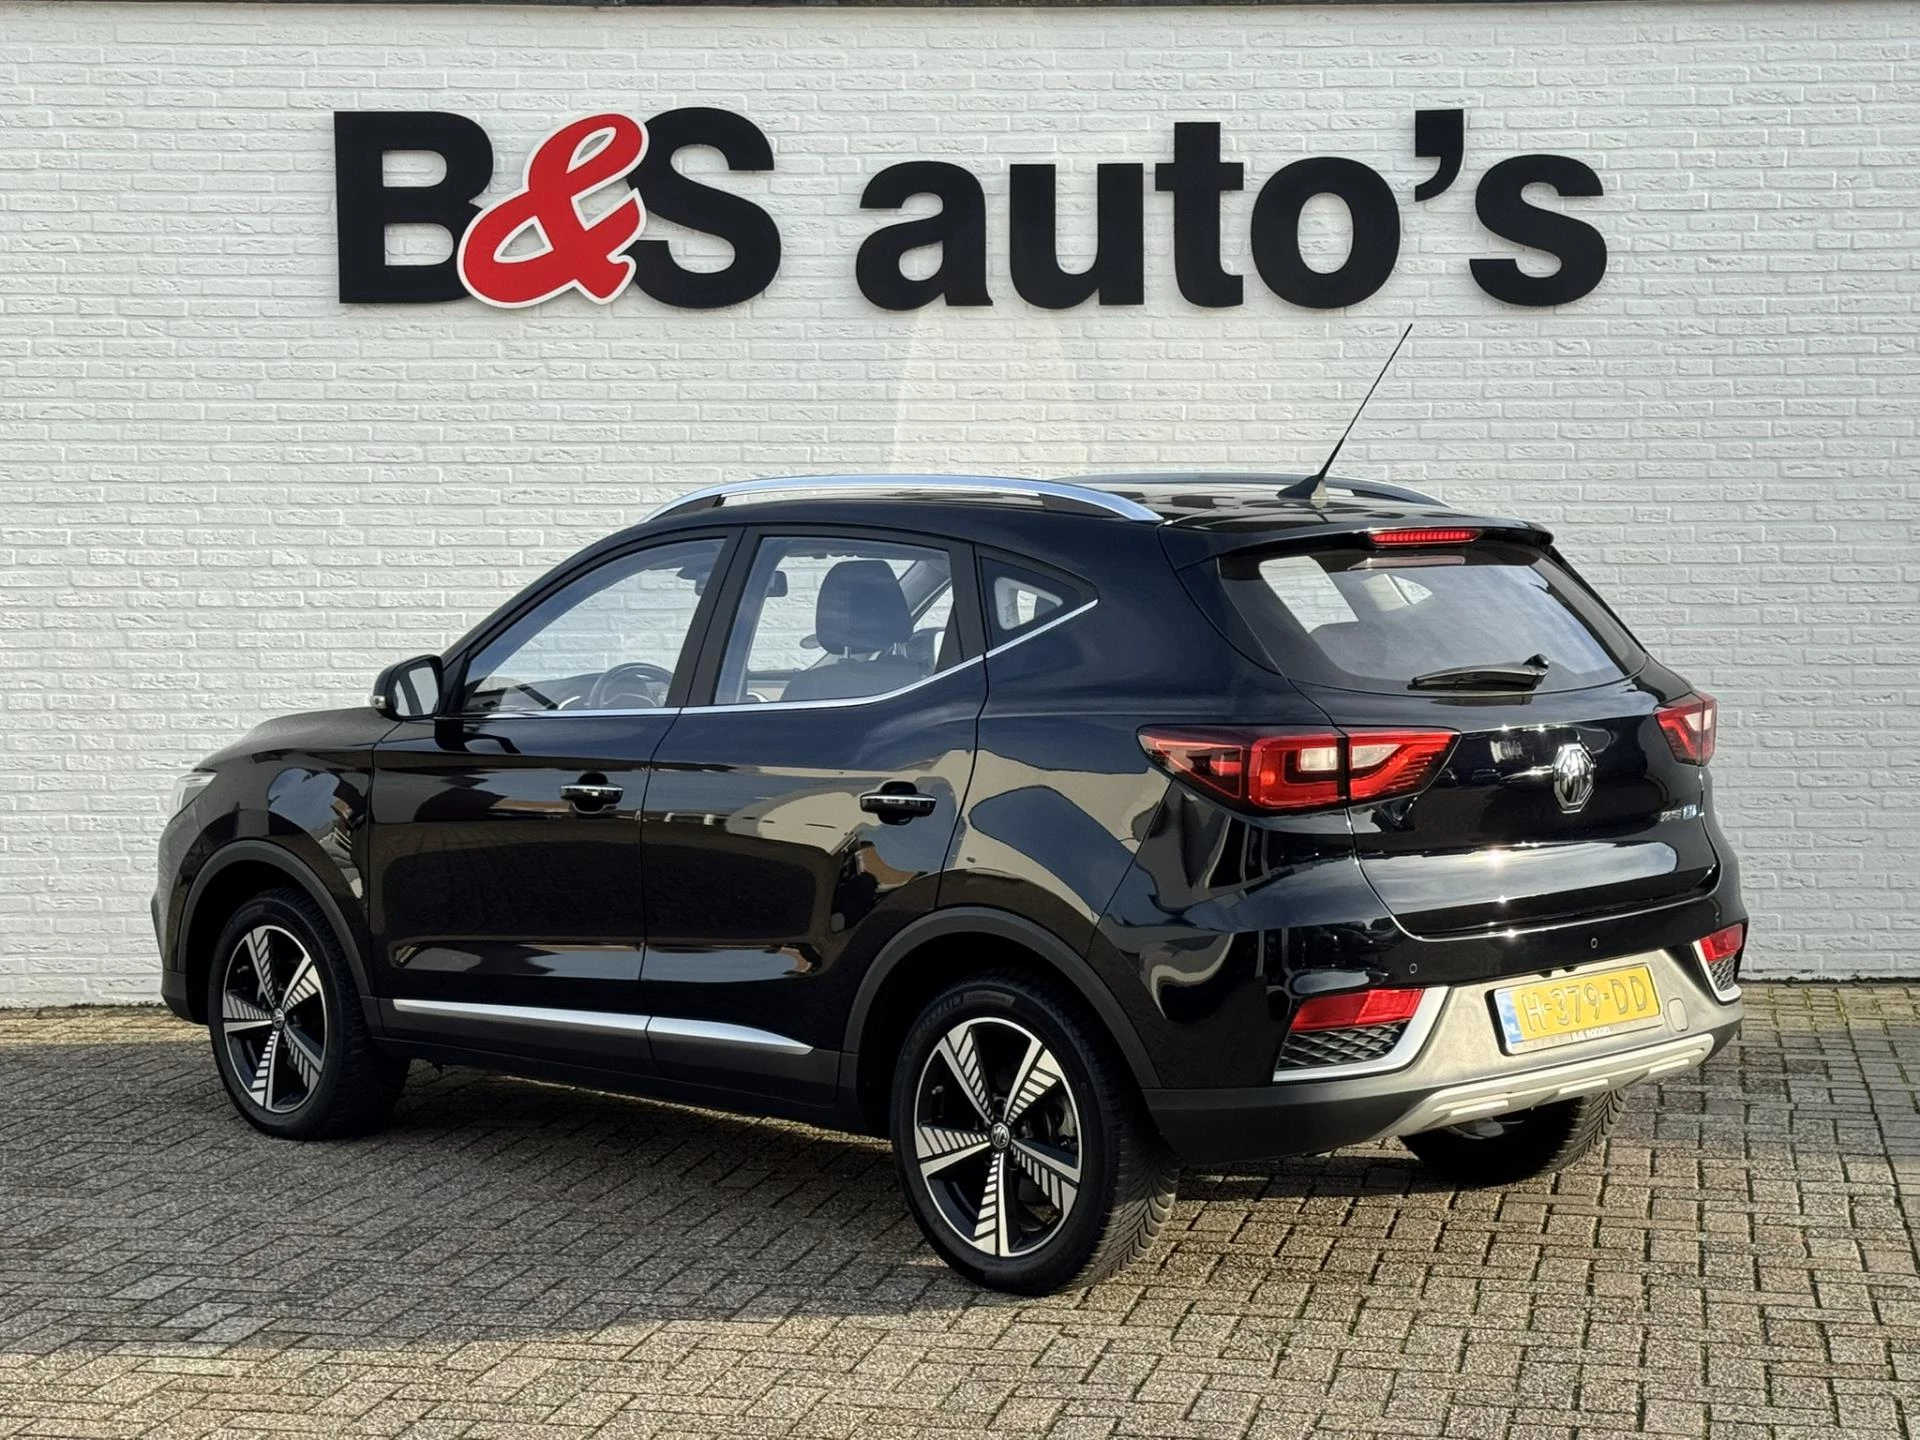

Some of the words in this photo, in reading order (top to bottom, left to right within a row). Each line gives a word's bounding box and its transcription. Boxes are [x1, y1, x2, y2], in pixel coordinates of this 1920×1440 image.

[334, 107, 781, 309] B&S
[856, 109, 1607, 311] auto's
[1520, 975, 1648, 1032] H-379-DD
